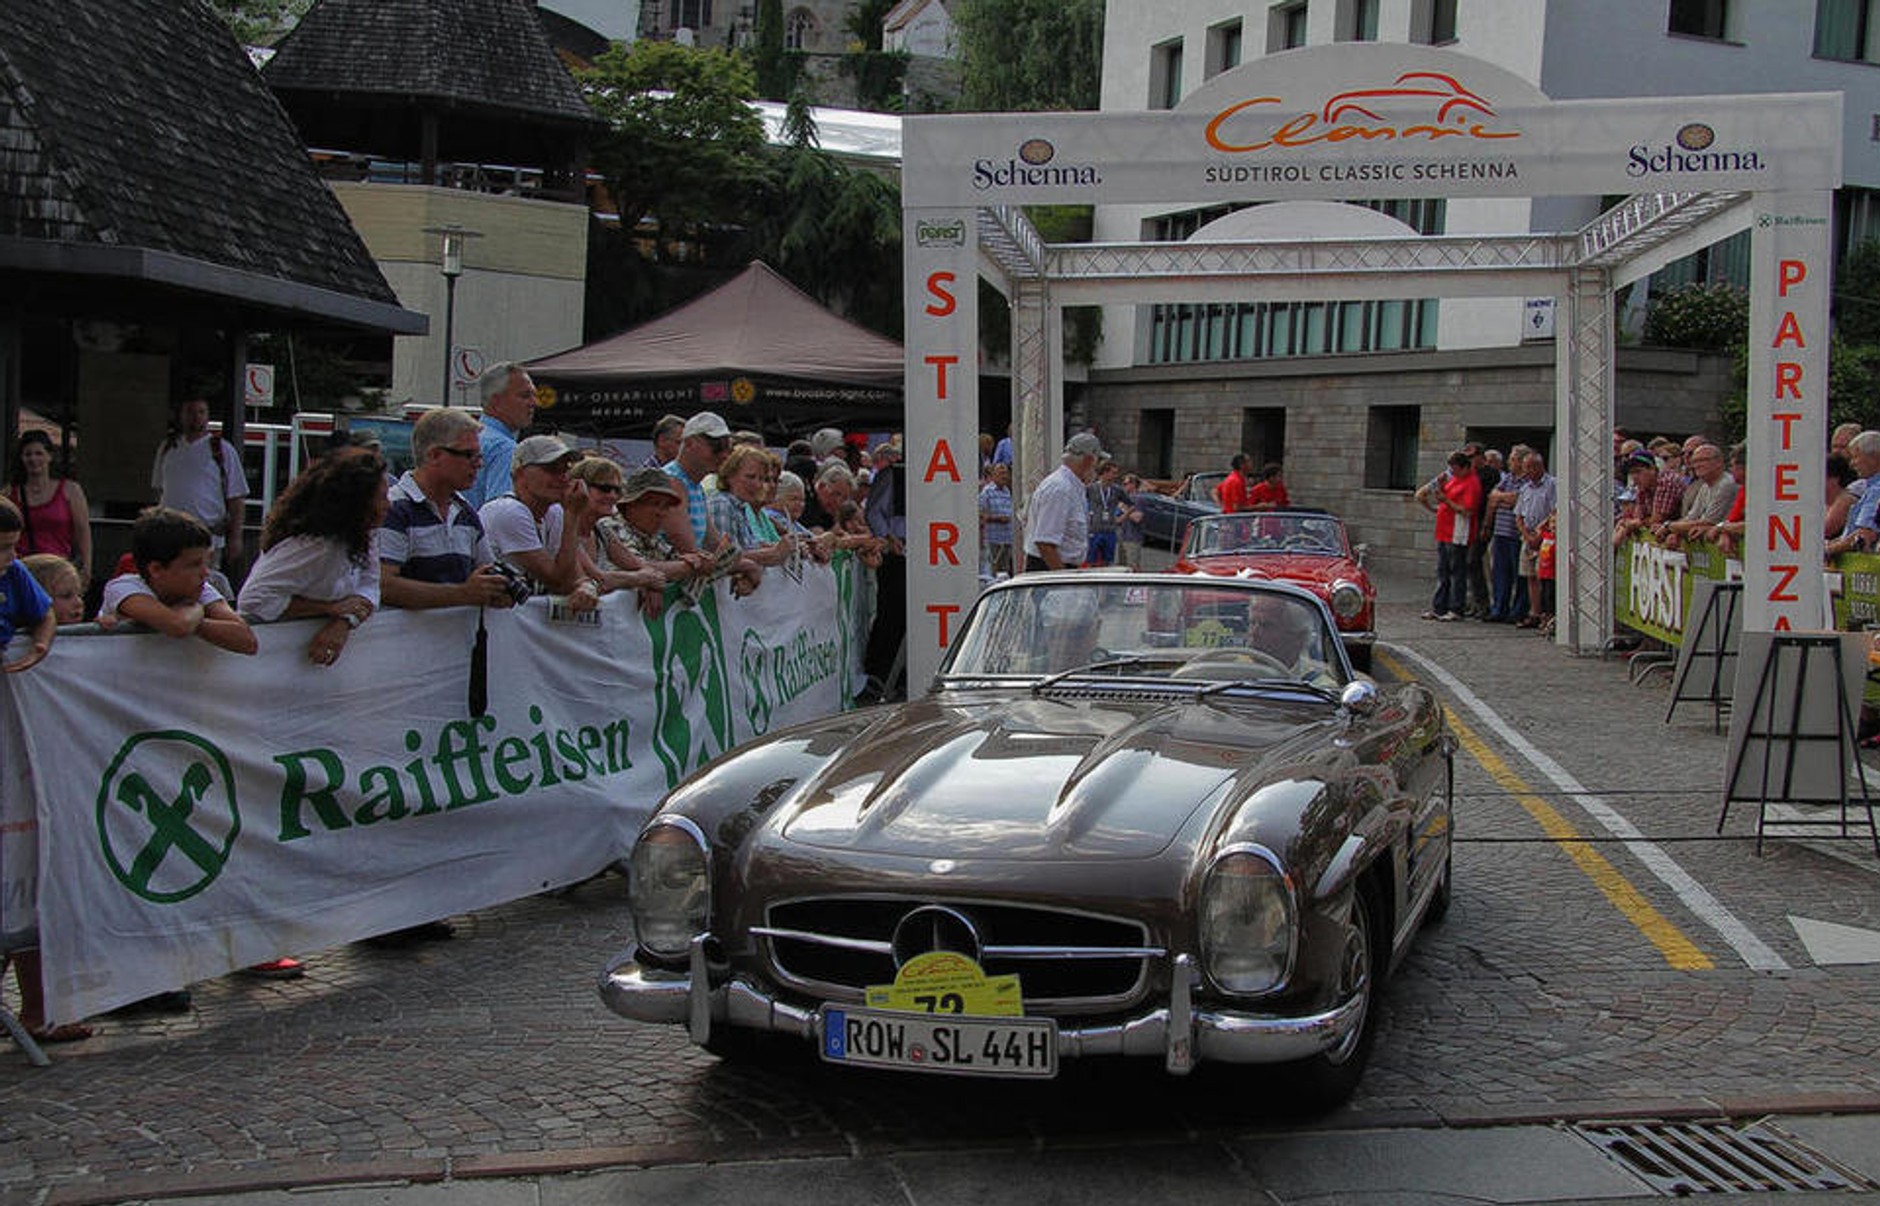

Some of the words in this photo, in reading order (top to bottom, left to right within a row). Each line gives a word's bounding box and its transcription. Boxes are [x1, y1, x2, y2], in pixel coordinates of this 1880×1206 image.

[1206, 166, 1311, 183] SÜDTIROL
[1320, 164, 1404, 181] CLASSIC
[1414, 162, 1518, 180] SCHENNA
[923, 271, 961, 648] START
[273, 704, 634, 842] Raiffeisen
[846, 1018, 905, 1058] ROW
[932, 1027, 973, 1064] SL
[982, 1030, 1048, 1067] 44H
